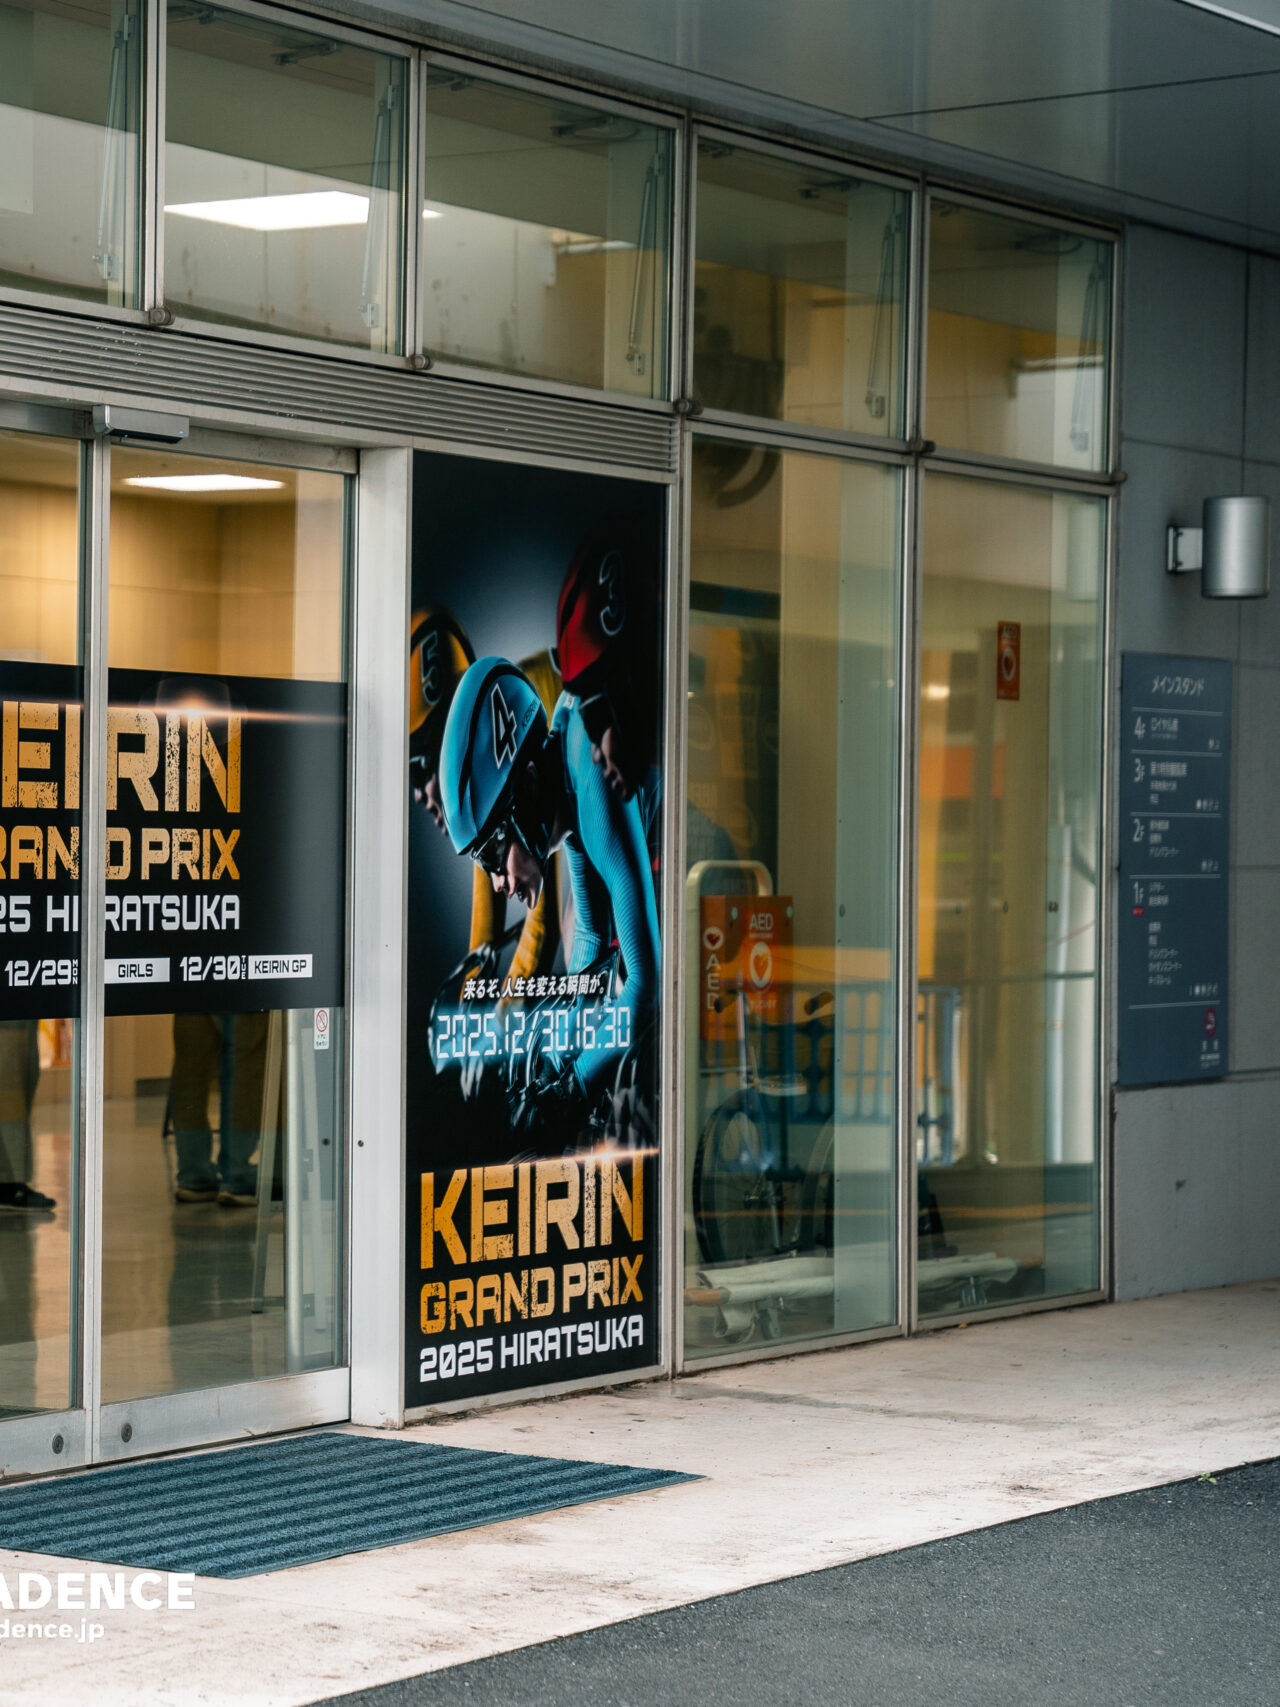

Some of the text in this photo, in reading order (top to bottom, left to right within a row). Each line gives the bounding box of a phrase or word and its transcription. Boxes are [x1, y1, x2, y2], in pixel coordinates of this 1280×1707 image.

[420, 629, 441, 706] 5
[490, 682, 518, 770] 4
[141, 828, 240, 880] PRIX
[46, 895, 241, 933] HIRATSUKA
[750, 912, 773, 930] AED
[4, 959, 71, 988] 12/29
[118, 963, 154, 978] GIRLS
[179, 954, 240, 982] 12/30
[254, 960, 290, 975] KEIRIN
[292, 959, 308, 973] GP
[463, 974, 606, 1000] 来るぞ、人生を変える瞬間が。
[420, 1153, 644, 1270] KEIRIN
[420, 1254, 644, 1335] GRAND PRIX
[420, 1314, 644, 1383] 2025 HIRATSUKA
